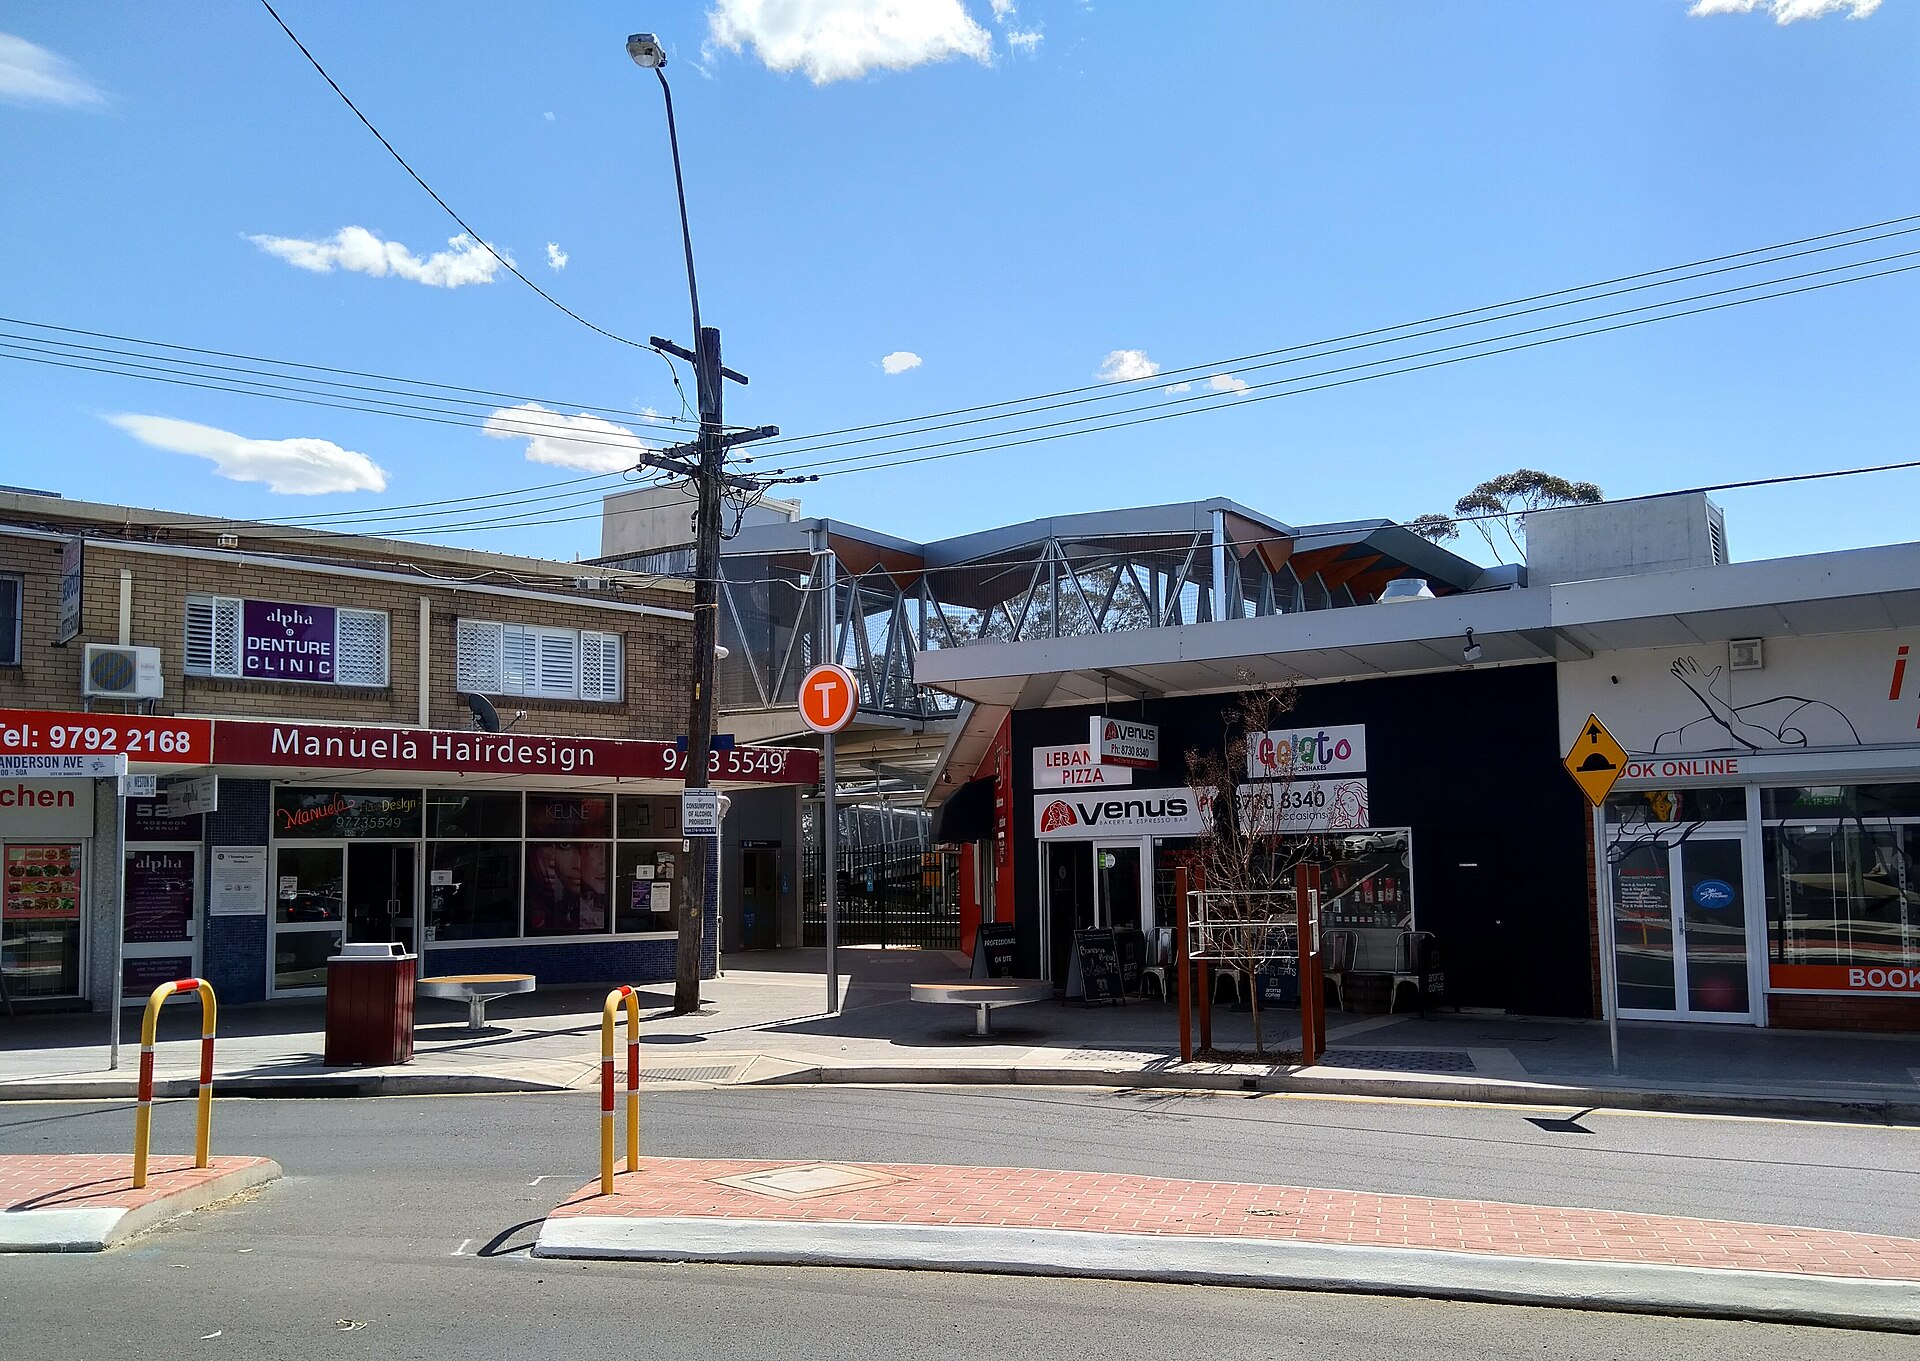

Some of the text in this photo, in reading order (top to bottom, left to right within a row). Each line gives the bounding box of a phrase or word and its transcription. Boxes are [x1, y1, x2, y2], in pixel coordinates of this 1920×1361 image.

[266, 608, 314, 628] alpha
[247, 636, 331, 656] DENTURE
[247, 655, 331, 674] CLINIC
[814, 682, 836, 719] T
[0, 723, 190, 753] el: 9792 2168
[271, 728, 783, 779] Manuela Hairdesign 973 5549
[1259, 731, 1351, 768] Gelato
[0, 756, 83, 768] ANDERSON AVE
[1662, 761, 1739, 777] ONLINE
[1062, 768, 1104, 784] PIZZA
[0, 784, 75, 807] chen
[382, 797, 416, 813] Design
[1280, 791, 1325, 809] 8340
[545, 803, 590, 820] KEUNE
[336, 816, 402, 829] 97735549
[135, 854, 182, 873] alpha
[1849, 968, 1920, 988] BOOK
